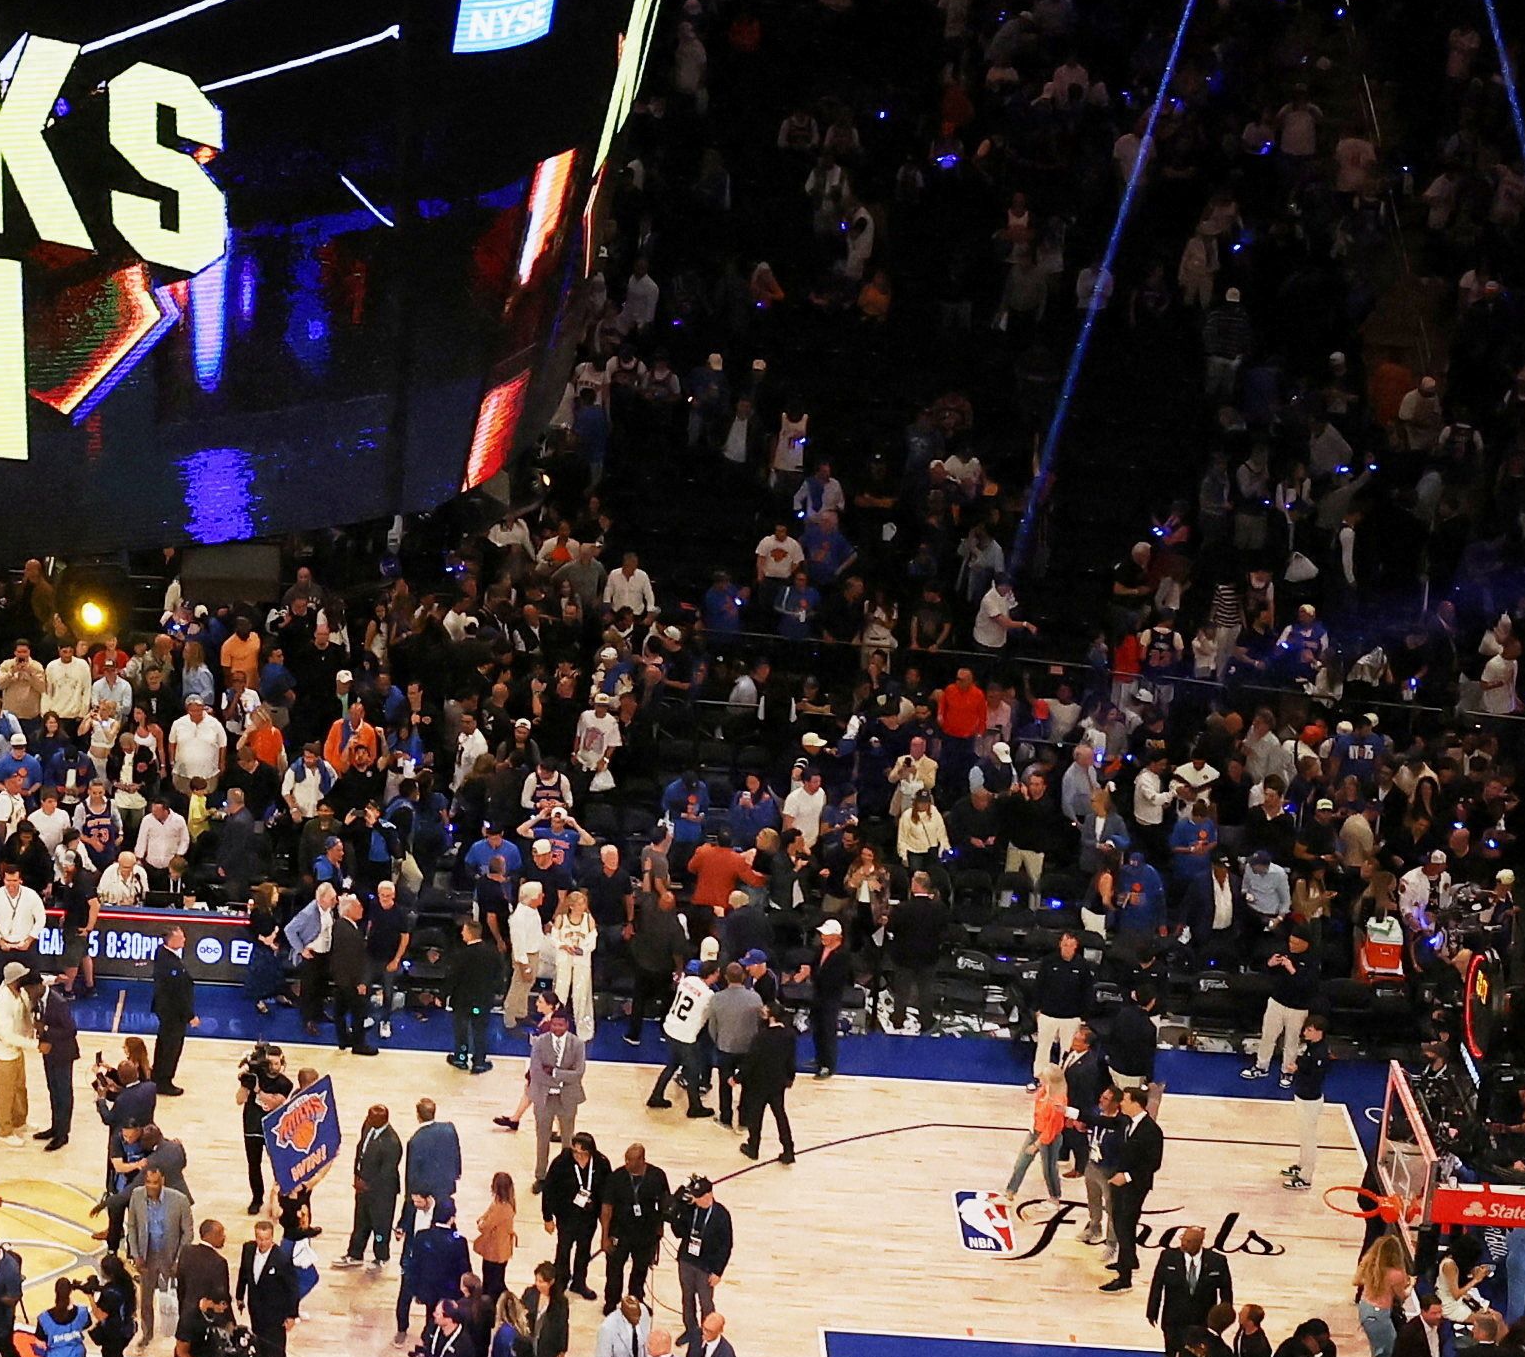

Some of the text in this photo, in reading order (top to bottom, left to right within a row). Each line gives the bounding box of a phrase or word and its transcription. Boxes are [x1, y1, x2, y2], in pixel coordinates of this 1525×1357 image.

[88, 931, 99, 958] 5
[673, 991, 694, 1022] 12
[290, 1144, 327, 1182] WIN!
[968, 1236, 996, 1252] NBA
